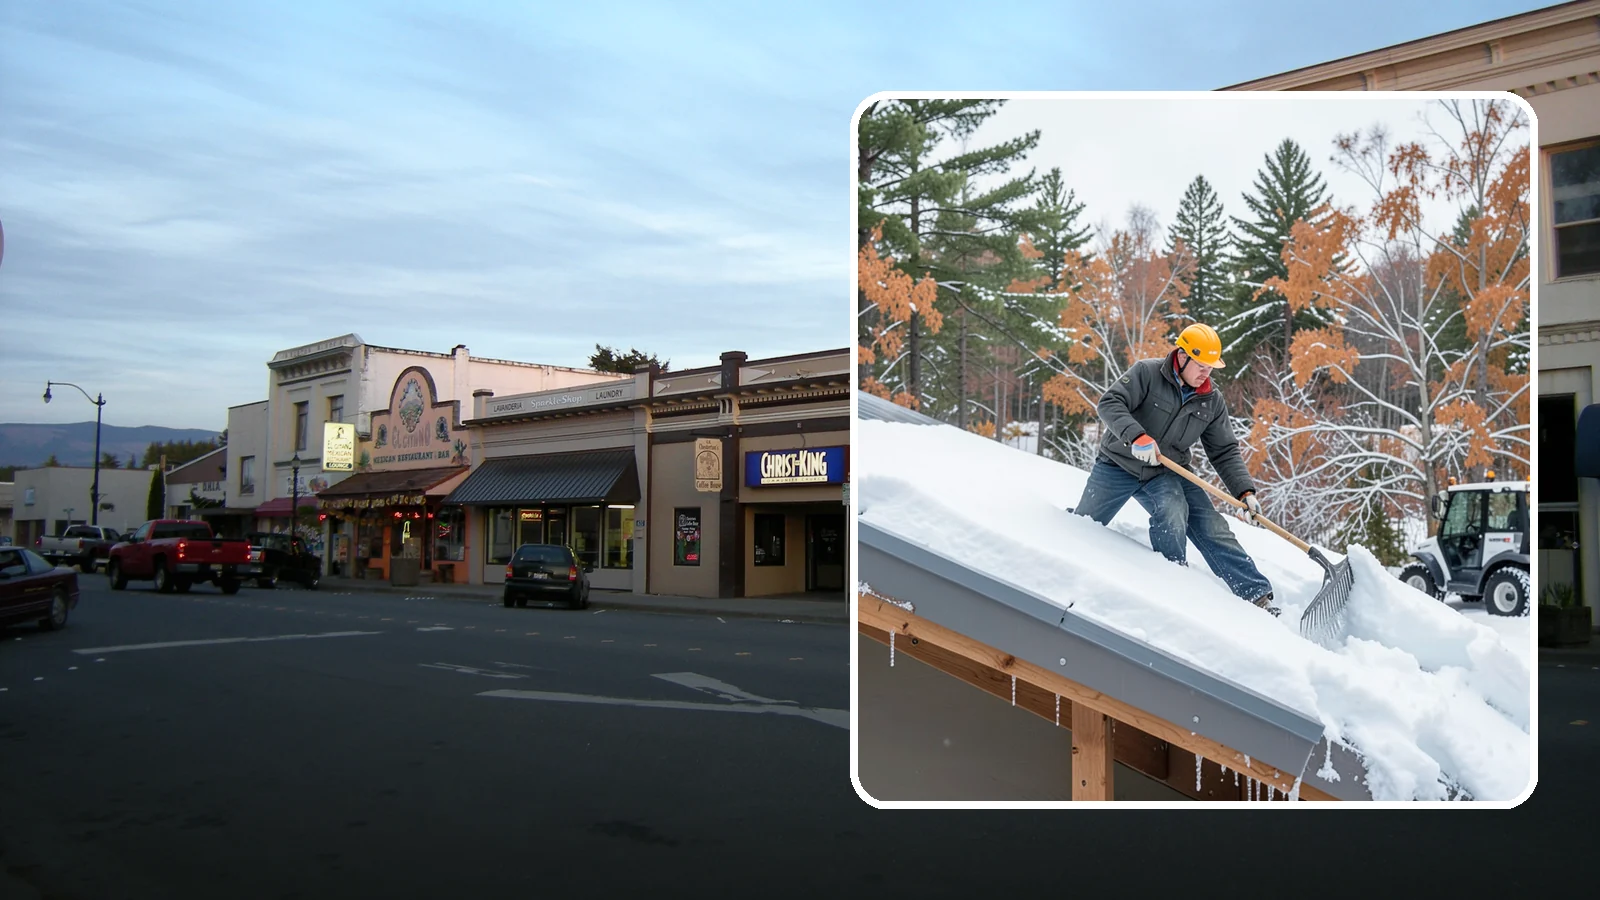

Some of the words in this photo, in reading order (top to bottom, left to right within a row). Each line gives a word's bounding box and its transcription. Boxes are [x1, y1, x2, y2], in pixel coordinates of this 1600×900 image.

[596, 389, 623, 400] LAUNDRY
[494, 402, 522, 412] LAVANDERIA
[374, 455, 396, 464] MEXICAN
[398, 451, 433, 463] RESTAURANT
[438, 450, 450, 459] BAR
[761, 452, 797, 478] CHRIST
[799, 450, 827, 476] KING
